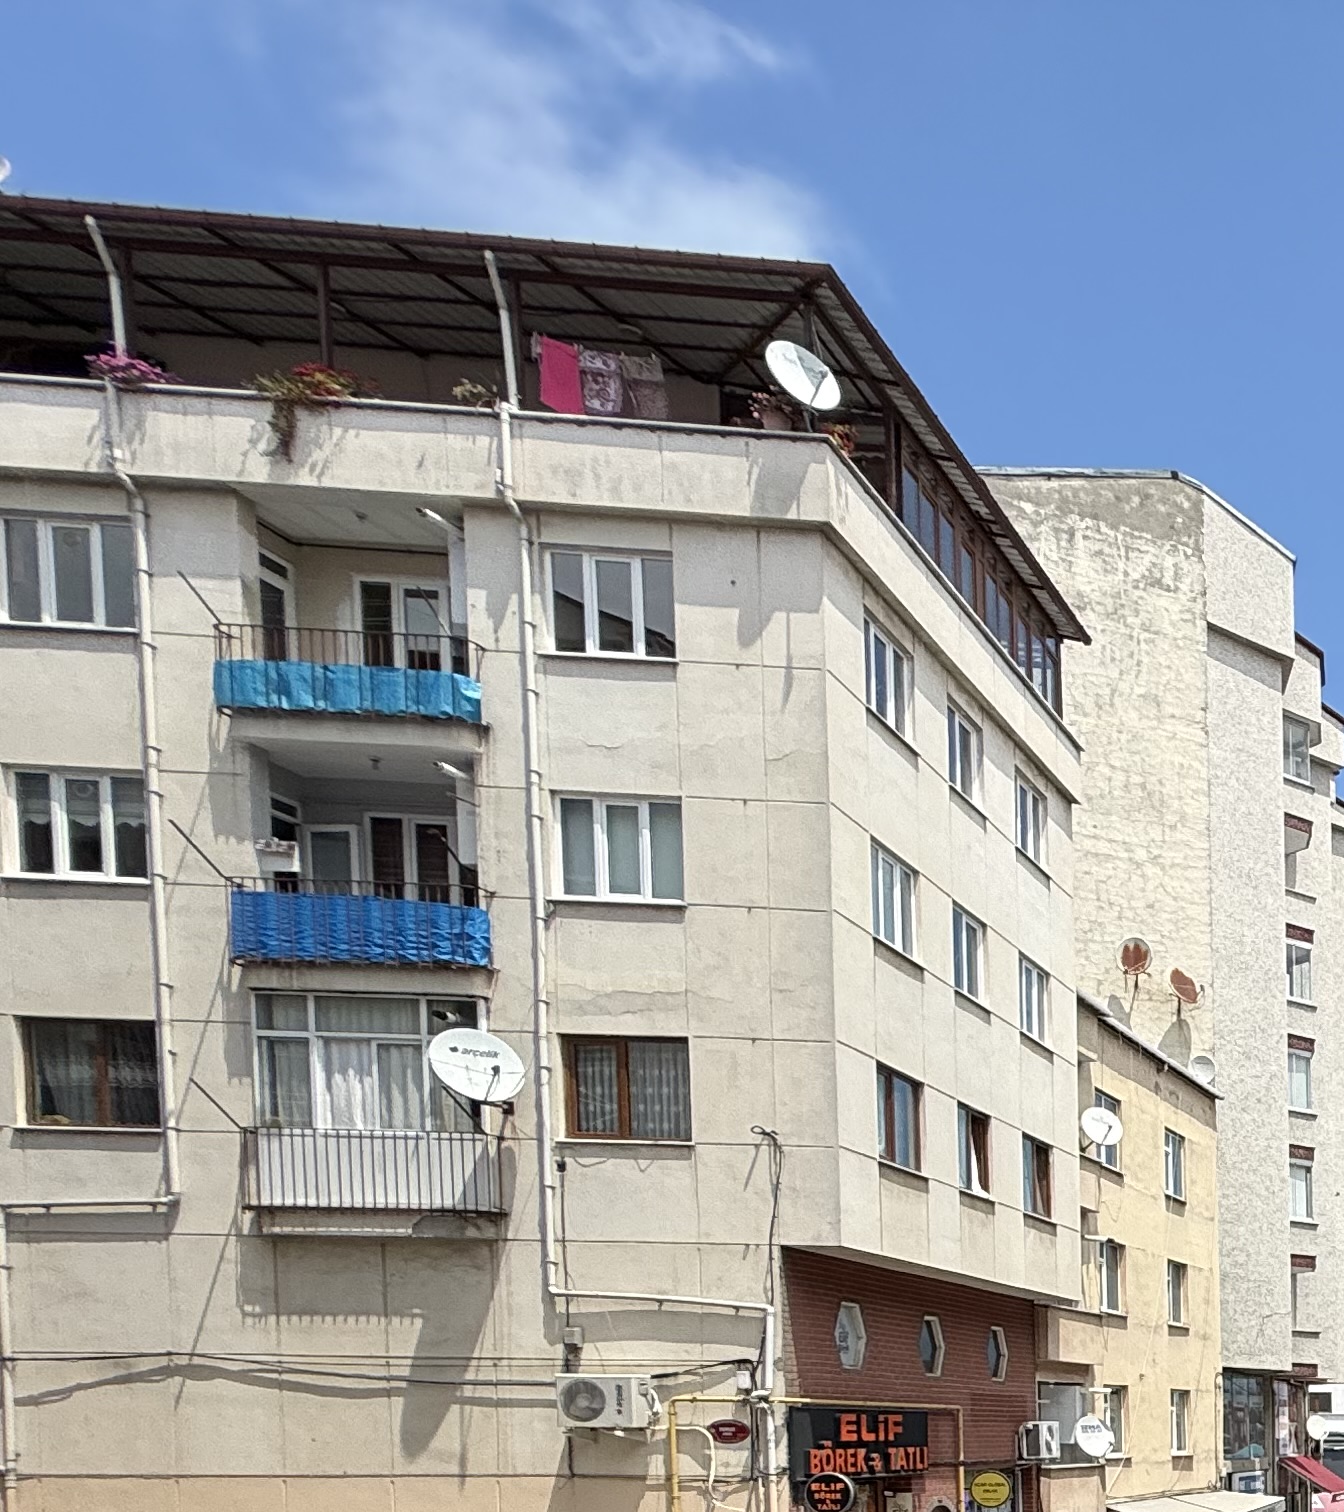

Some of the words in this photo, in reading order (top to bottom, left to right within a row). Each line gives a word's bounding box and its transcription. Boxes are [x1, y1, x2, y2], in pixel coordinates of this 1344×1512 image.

[460, 1047, 501, 1059] arçelik
[809, 1440, 867, 1475] BÖREK
[888, 1446, 929, 1471] TATLI
